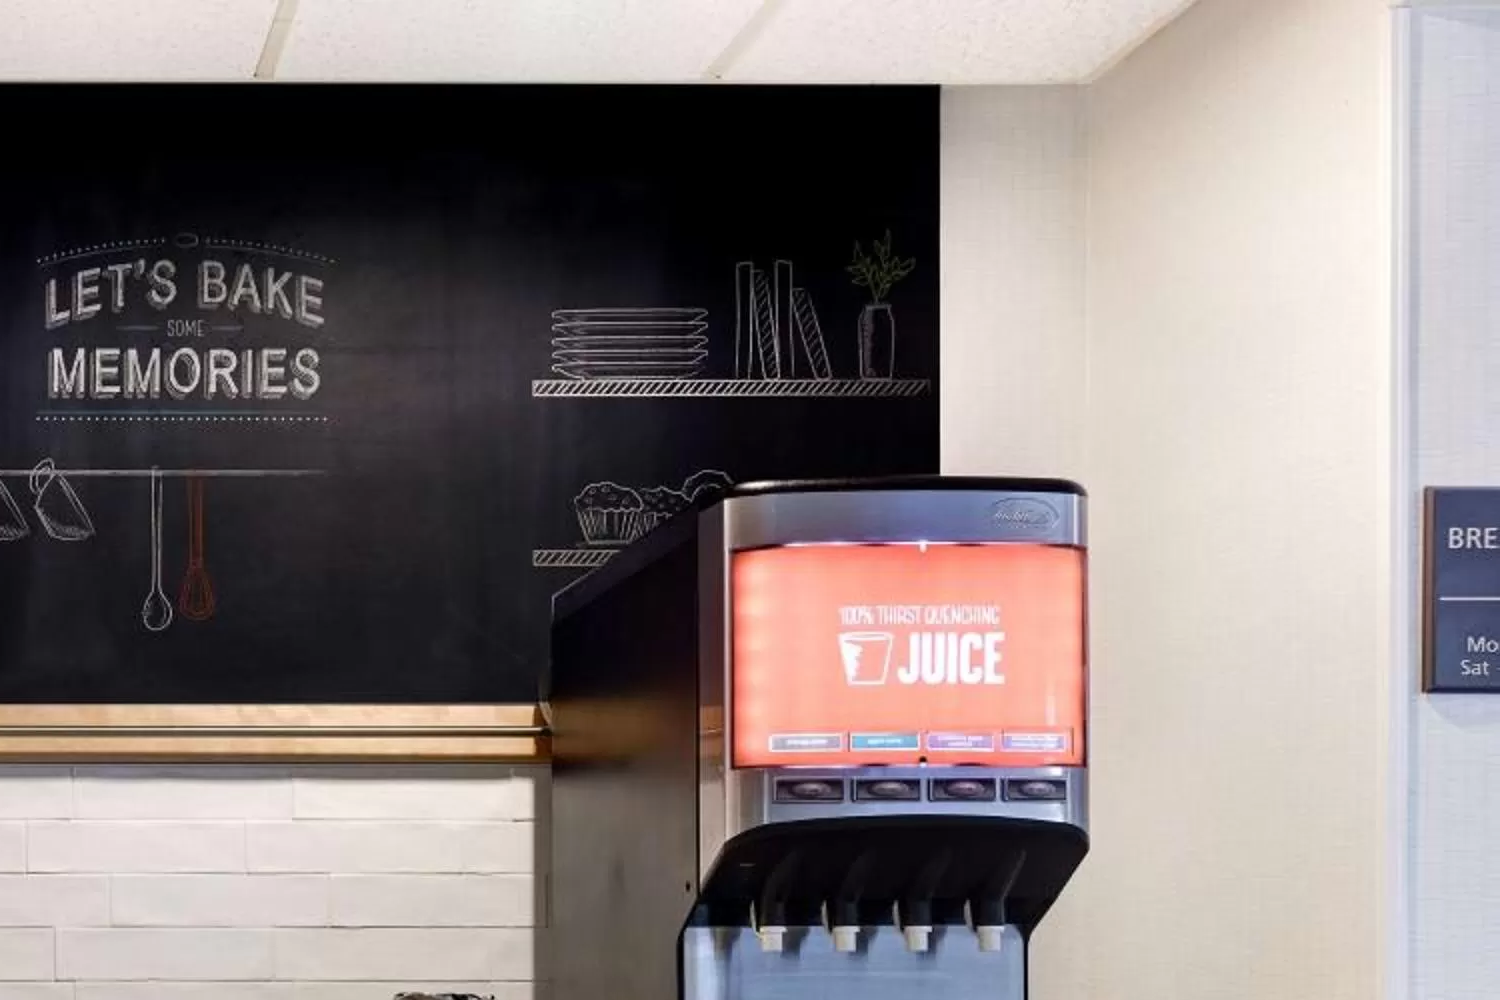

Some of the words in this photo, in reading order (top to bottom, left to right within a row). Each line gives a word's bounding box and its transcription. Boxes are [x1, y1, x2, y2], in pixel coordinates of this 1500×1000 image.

[45, 258, 178, 330] LET'S
[197, 259, 325, 329] BAKE
[167, 319, 205, 337] SOME
[47, 347, 321, 400] MEMORIES
[838, 605, 874, 625] 100%
[876, 605, 921, 625] THIRST
[924, 605, 1000, 625] QUENCHING
[897, 631, 1006, 685] JUICE
[1460, 659, 1490, 676] Sat
